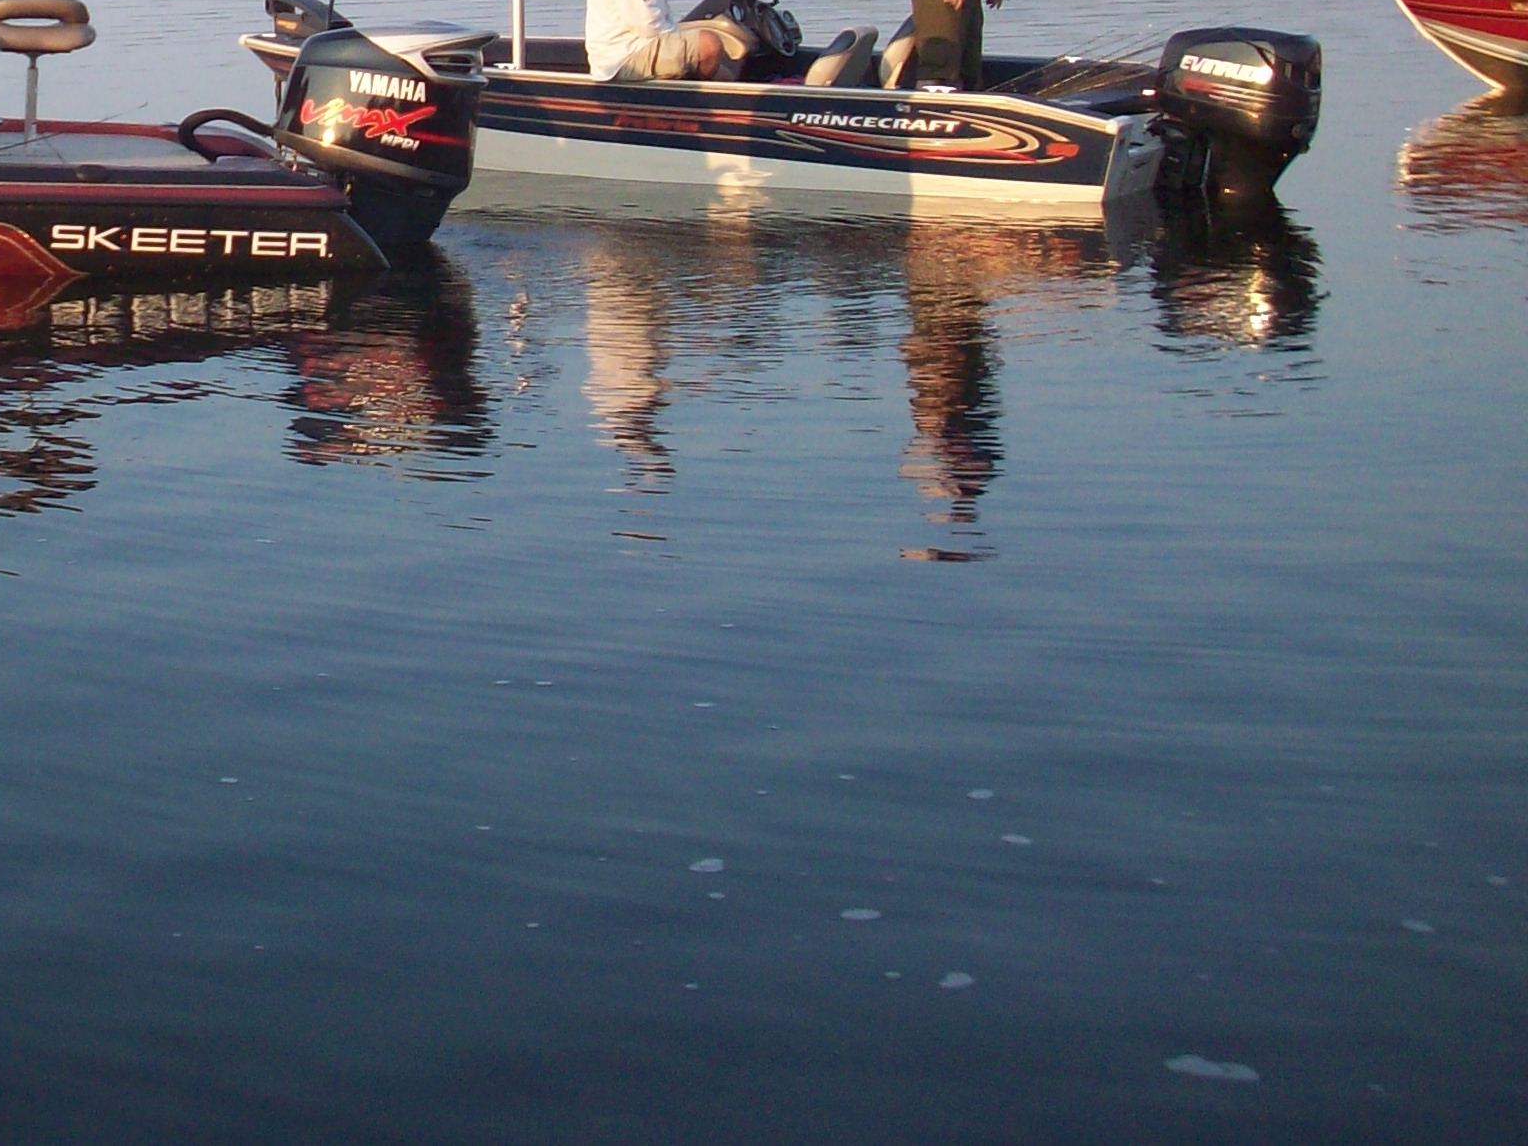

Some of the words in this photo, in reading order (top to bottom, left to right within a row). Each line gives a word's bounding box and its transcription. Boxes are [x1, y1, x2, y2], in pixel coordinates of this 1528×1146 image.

[1179, 54, 1273, 84] EVINRUD
[349, 70, 426, 102] YAMAHA
[791, 111, 960, 133] PRINCECRAFT
[379, 133, 420, 152] HPDI
[50, 224, 328, 257] SKEETER
